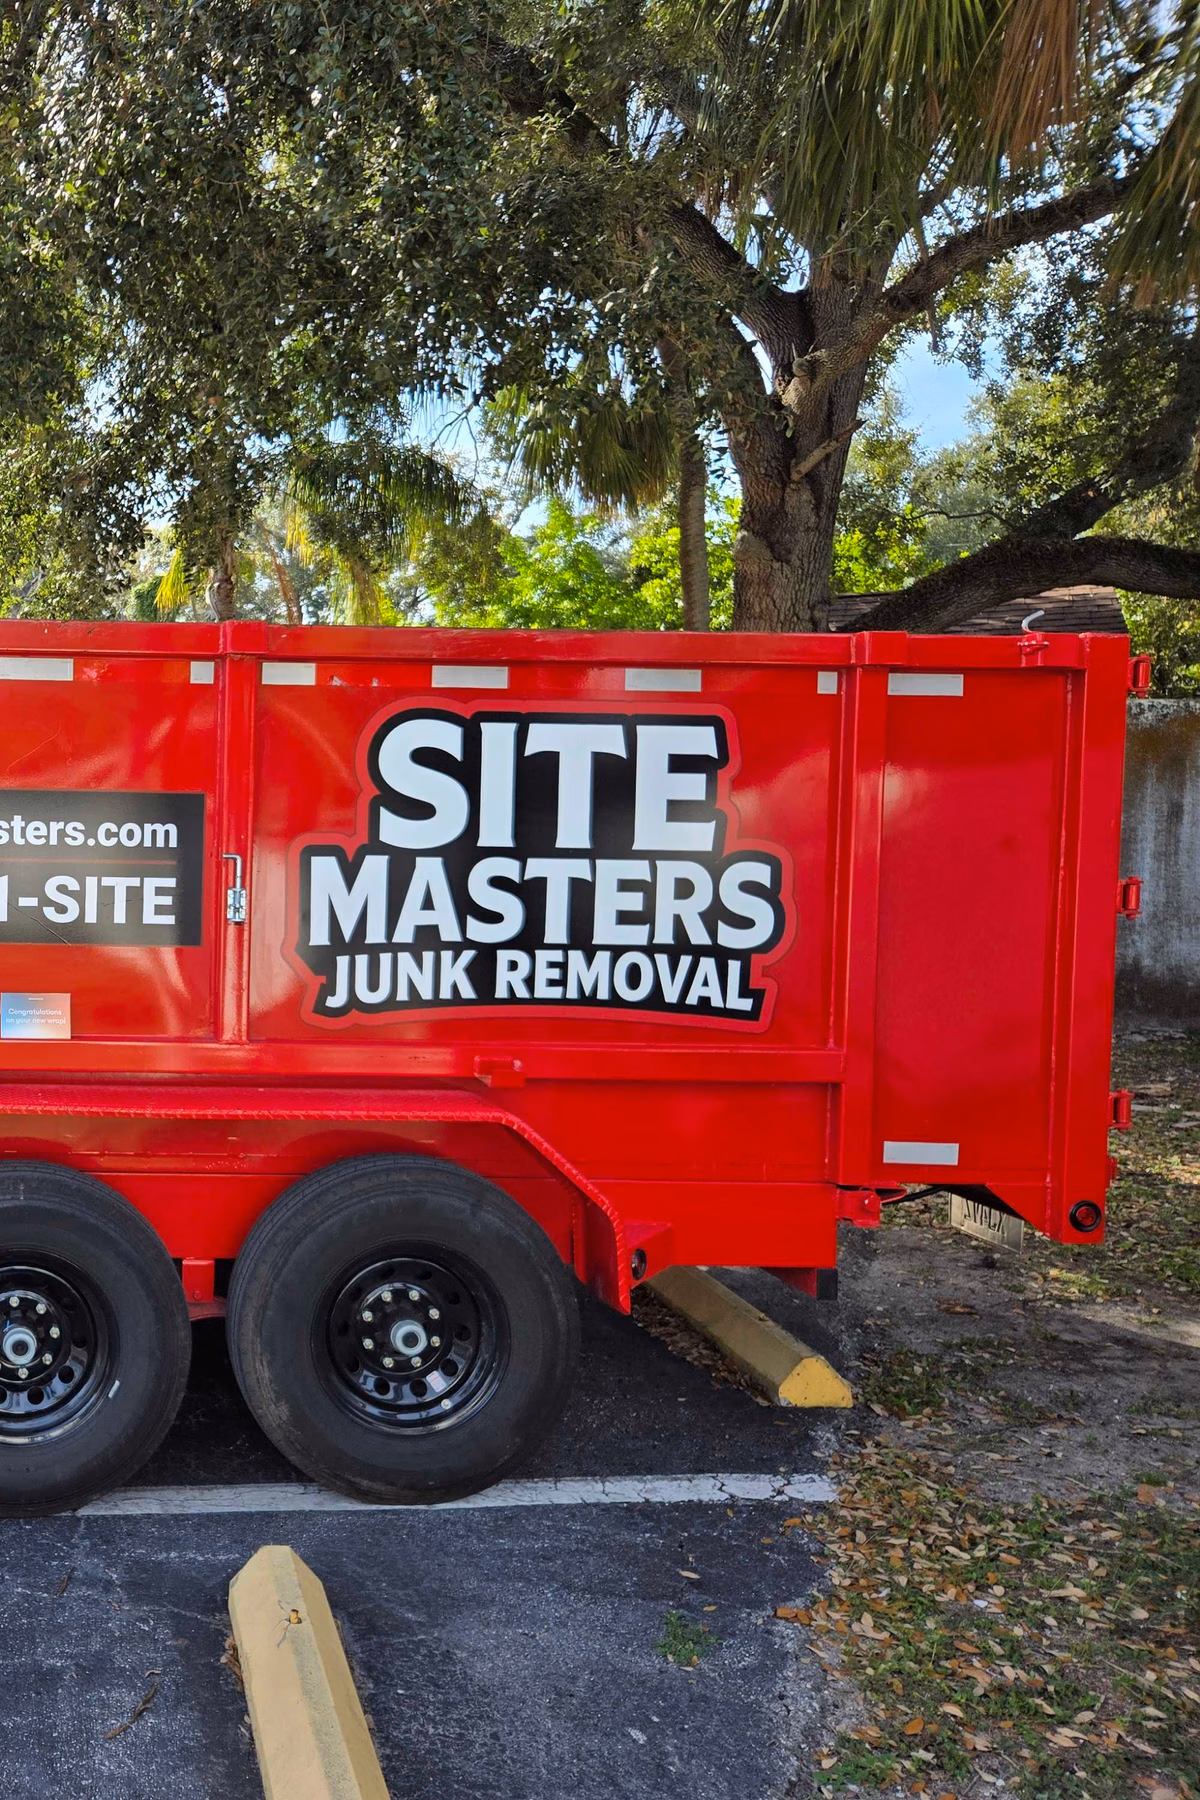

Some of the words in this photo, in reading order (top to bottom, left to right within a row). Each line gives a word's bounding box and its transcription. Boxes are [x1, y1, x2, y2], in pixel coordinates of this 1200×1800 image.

[378, 719, 718, 851] SITE
[309, 855, 775, 949] MASTERS
[8, 1008, 62, 1016] Congratulations
[326, 950, 477, 1008] JUNK
[495, 950, 754, 1011] REMOVAL
